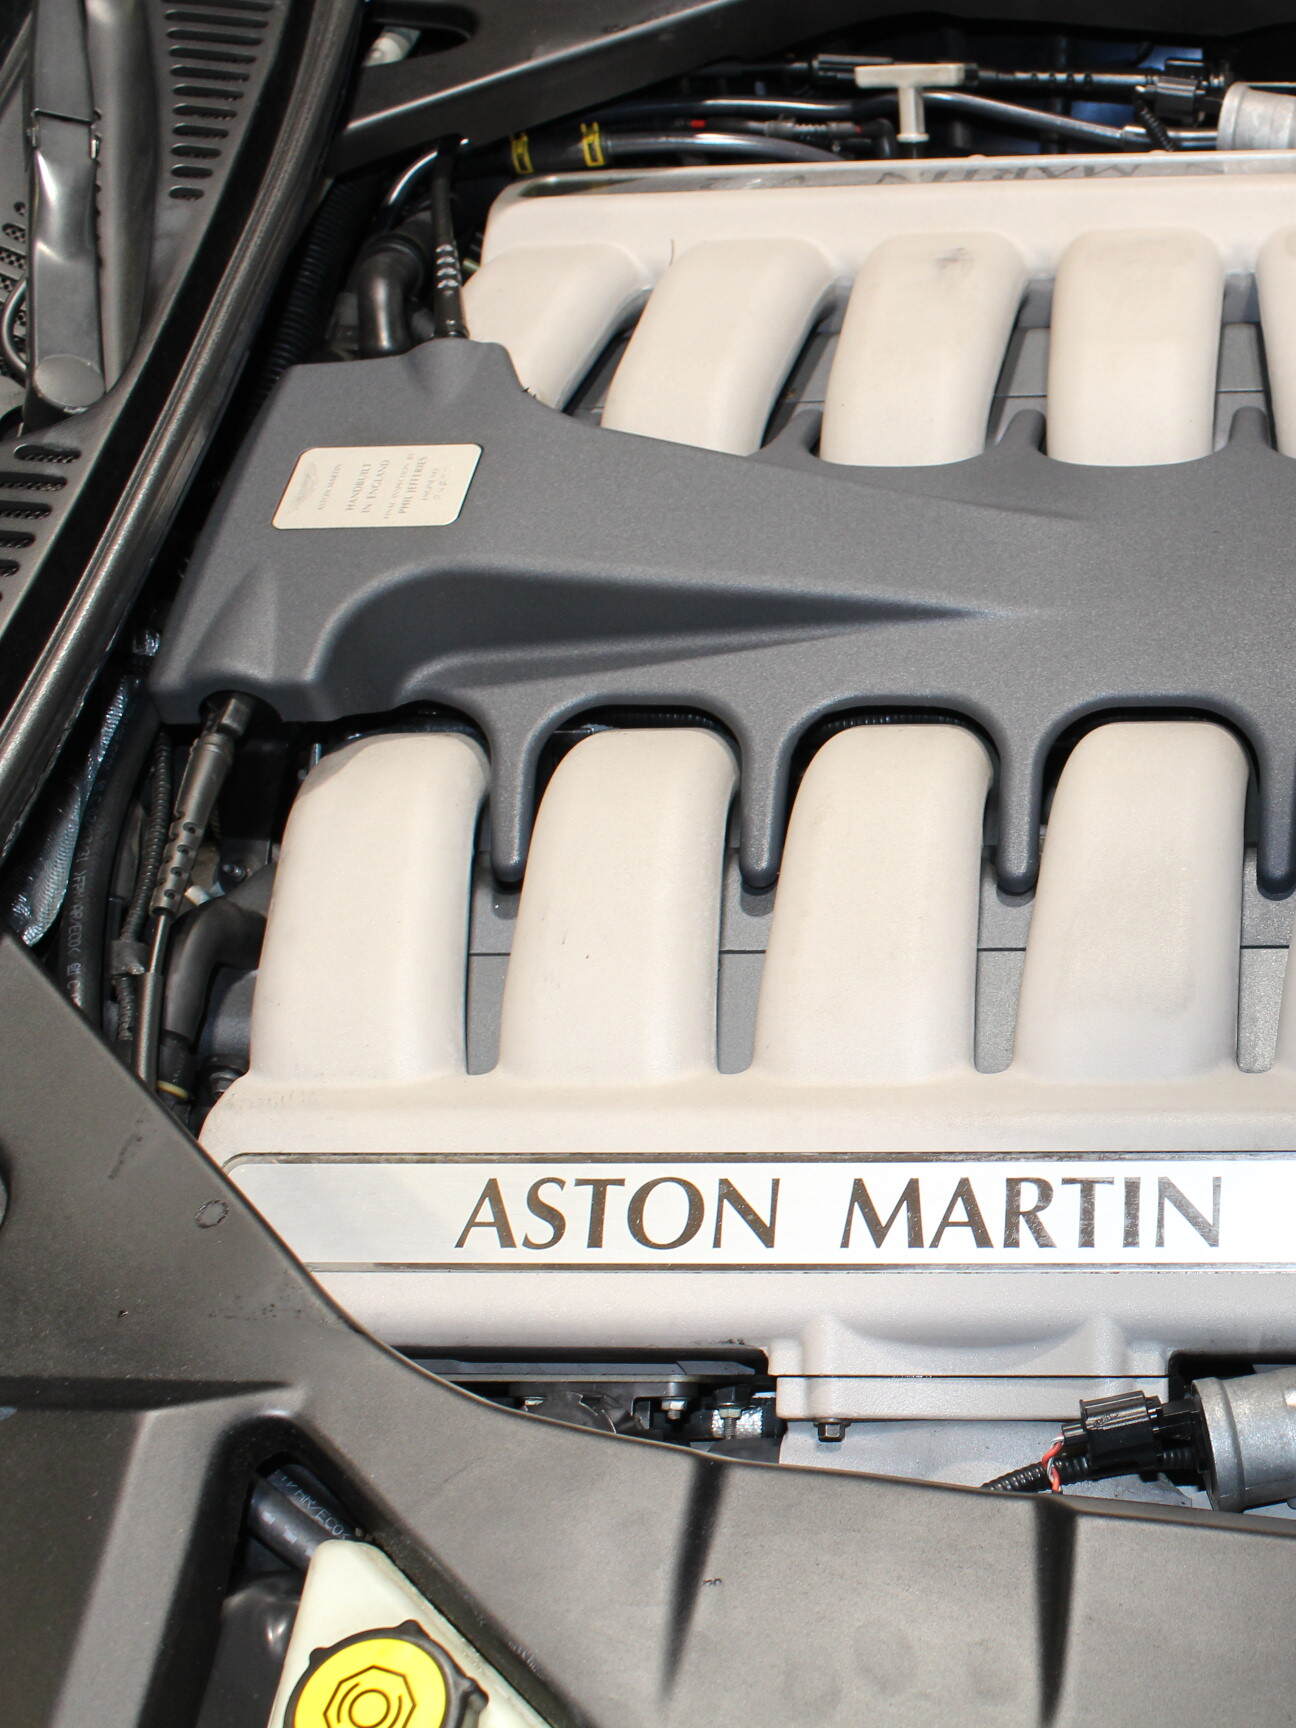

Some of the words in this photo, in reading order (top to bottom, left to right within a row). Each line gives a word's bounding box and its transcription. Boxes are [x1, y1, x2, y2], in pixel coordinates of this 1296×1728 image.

[346, 464, 372, 511] HANDBUILT
[366, 460, 390, 499] ENGLAND
[456, 1177, 780, 1250] ASTON
[840, 1175, 1222, 1250] MARTIN
